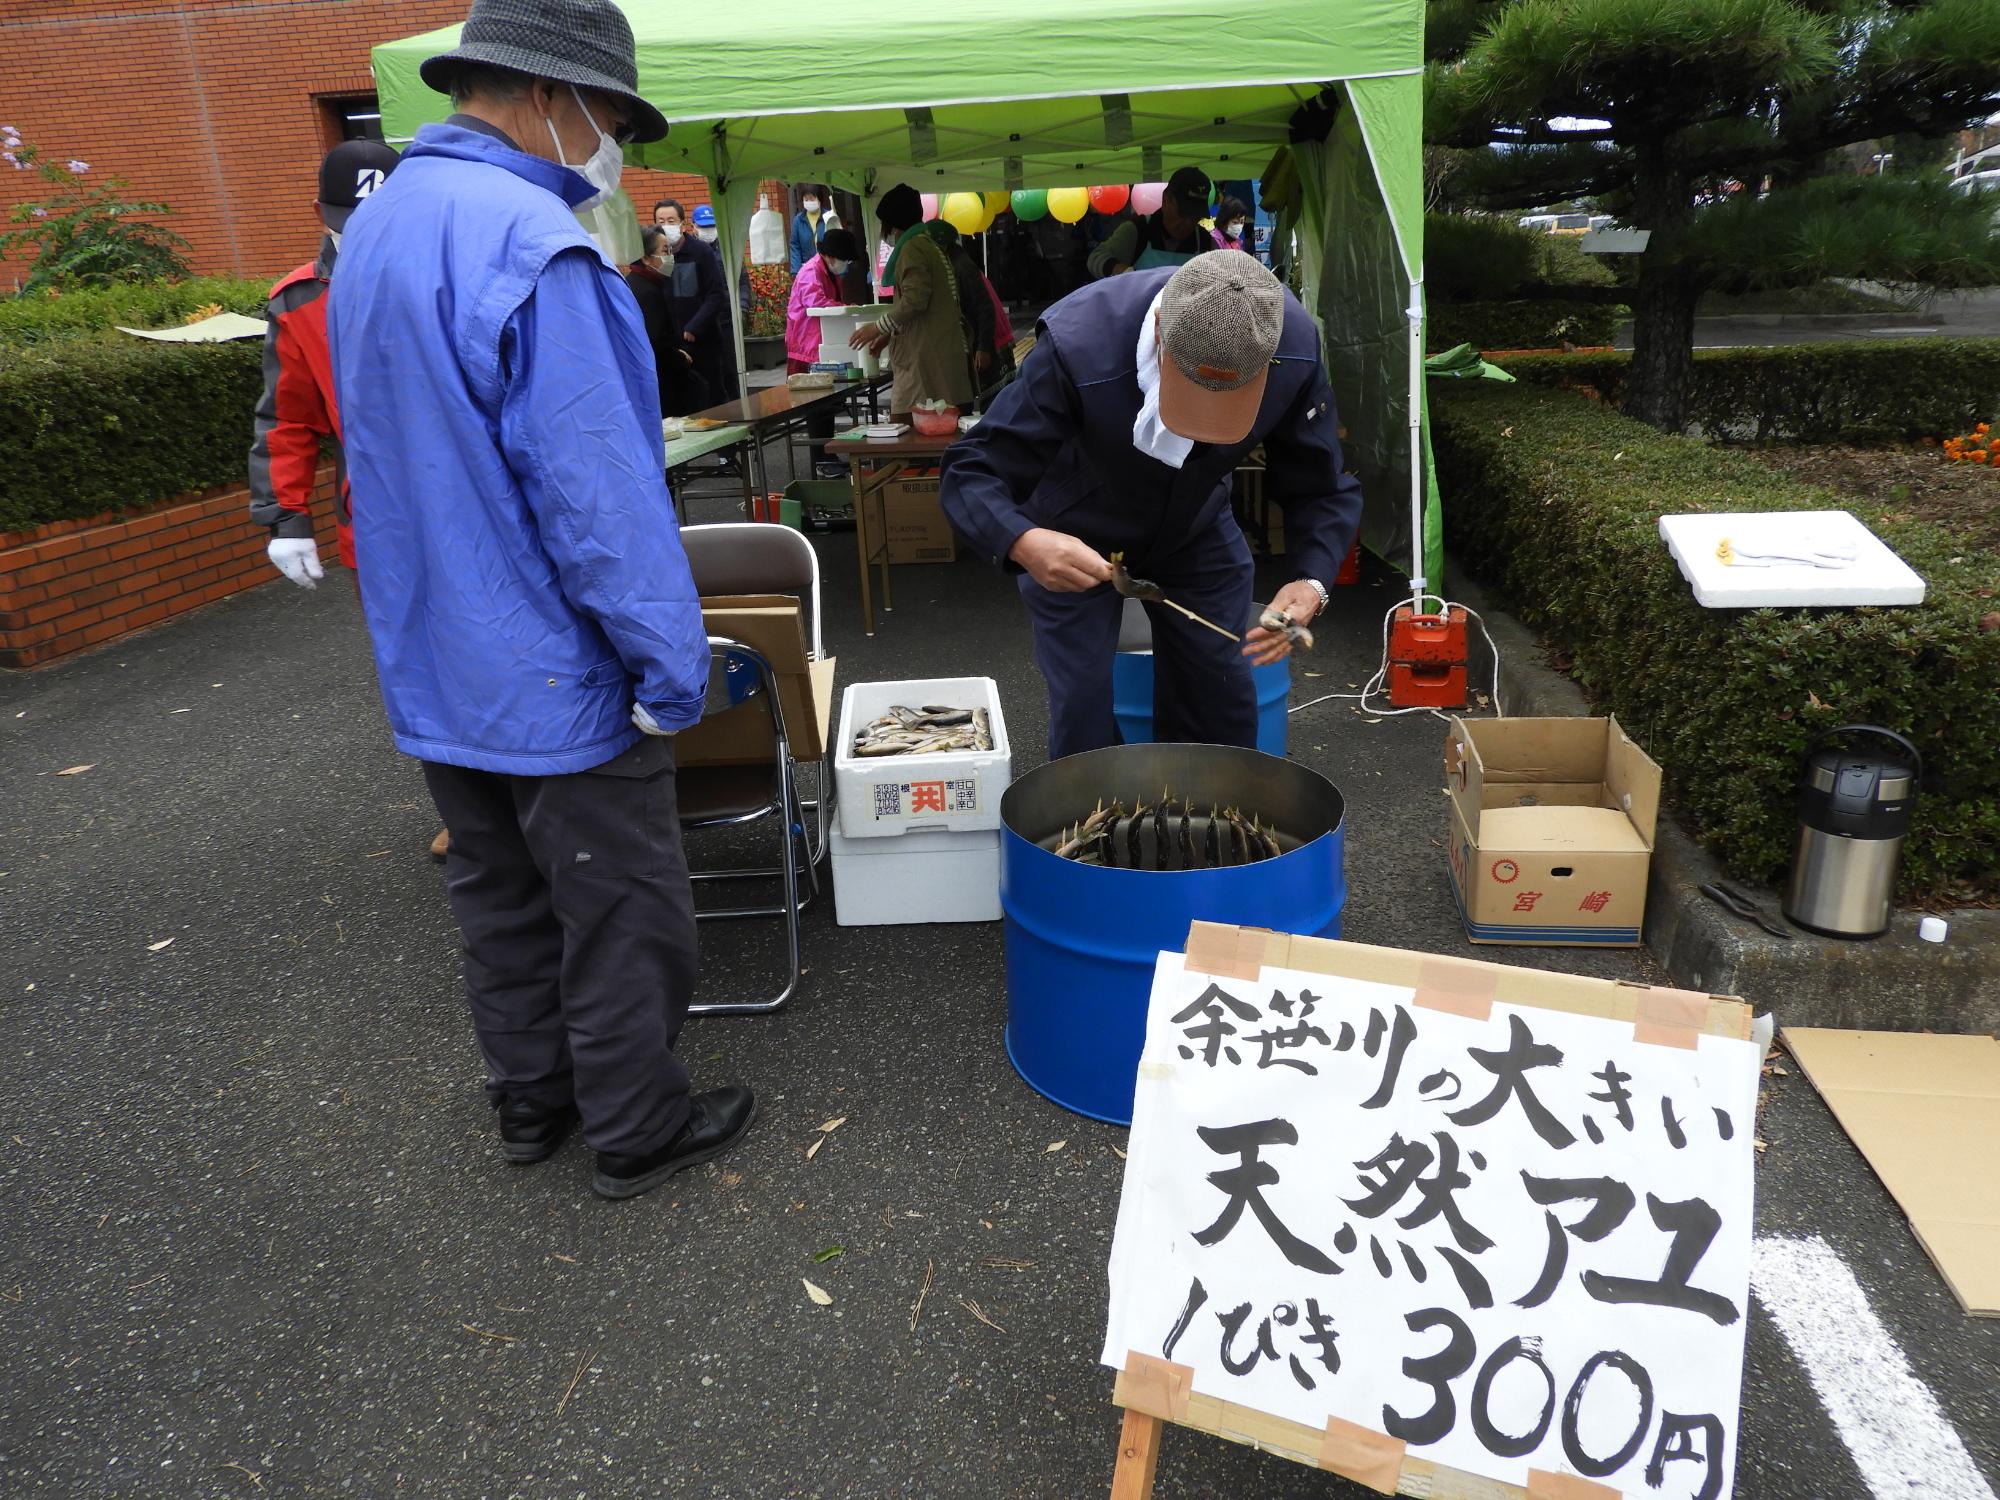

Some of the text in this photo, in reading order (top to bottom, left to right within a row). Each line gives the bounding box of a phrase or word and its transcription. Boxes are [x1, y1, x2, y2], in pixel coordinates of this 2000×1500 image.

[957, 781, 974, 790] 甘口
[1171, 983, 1734, 1149] 余笹川の大きい
[1191, 1117, 1740, 1325] 天然アユ
